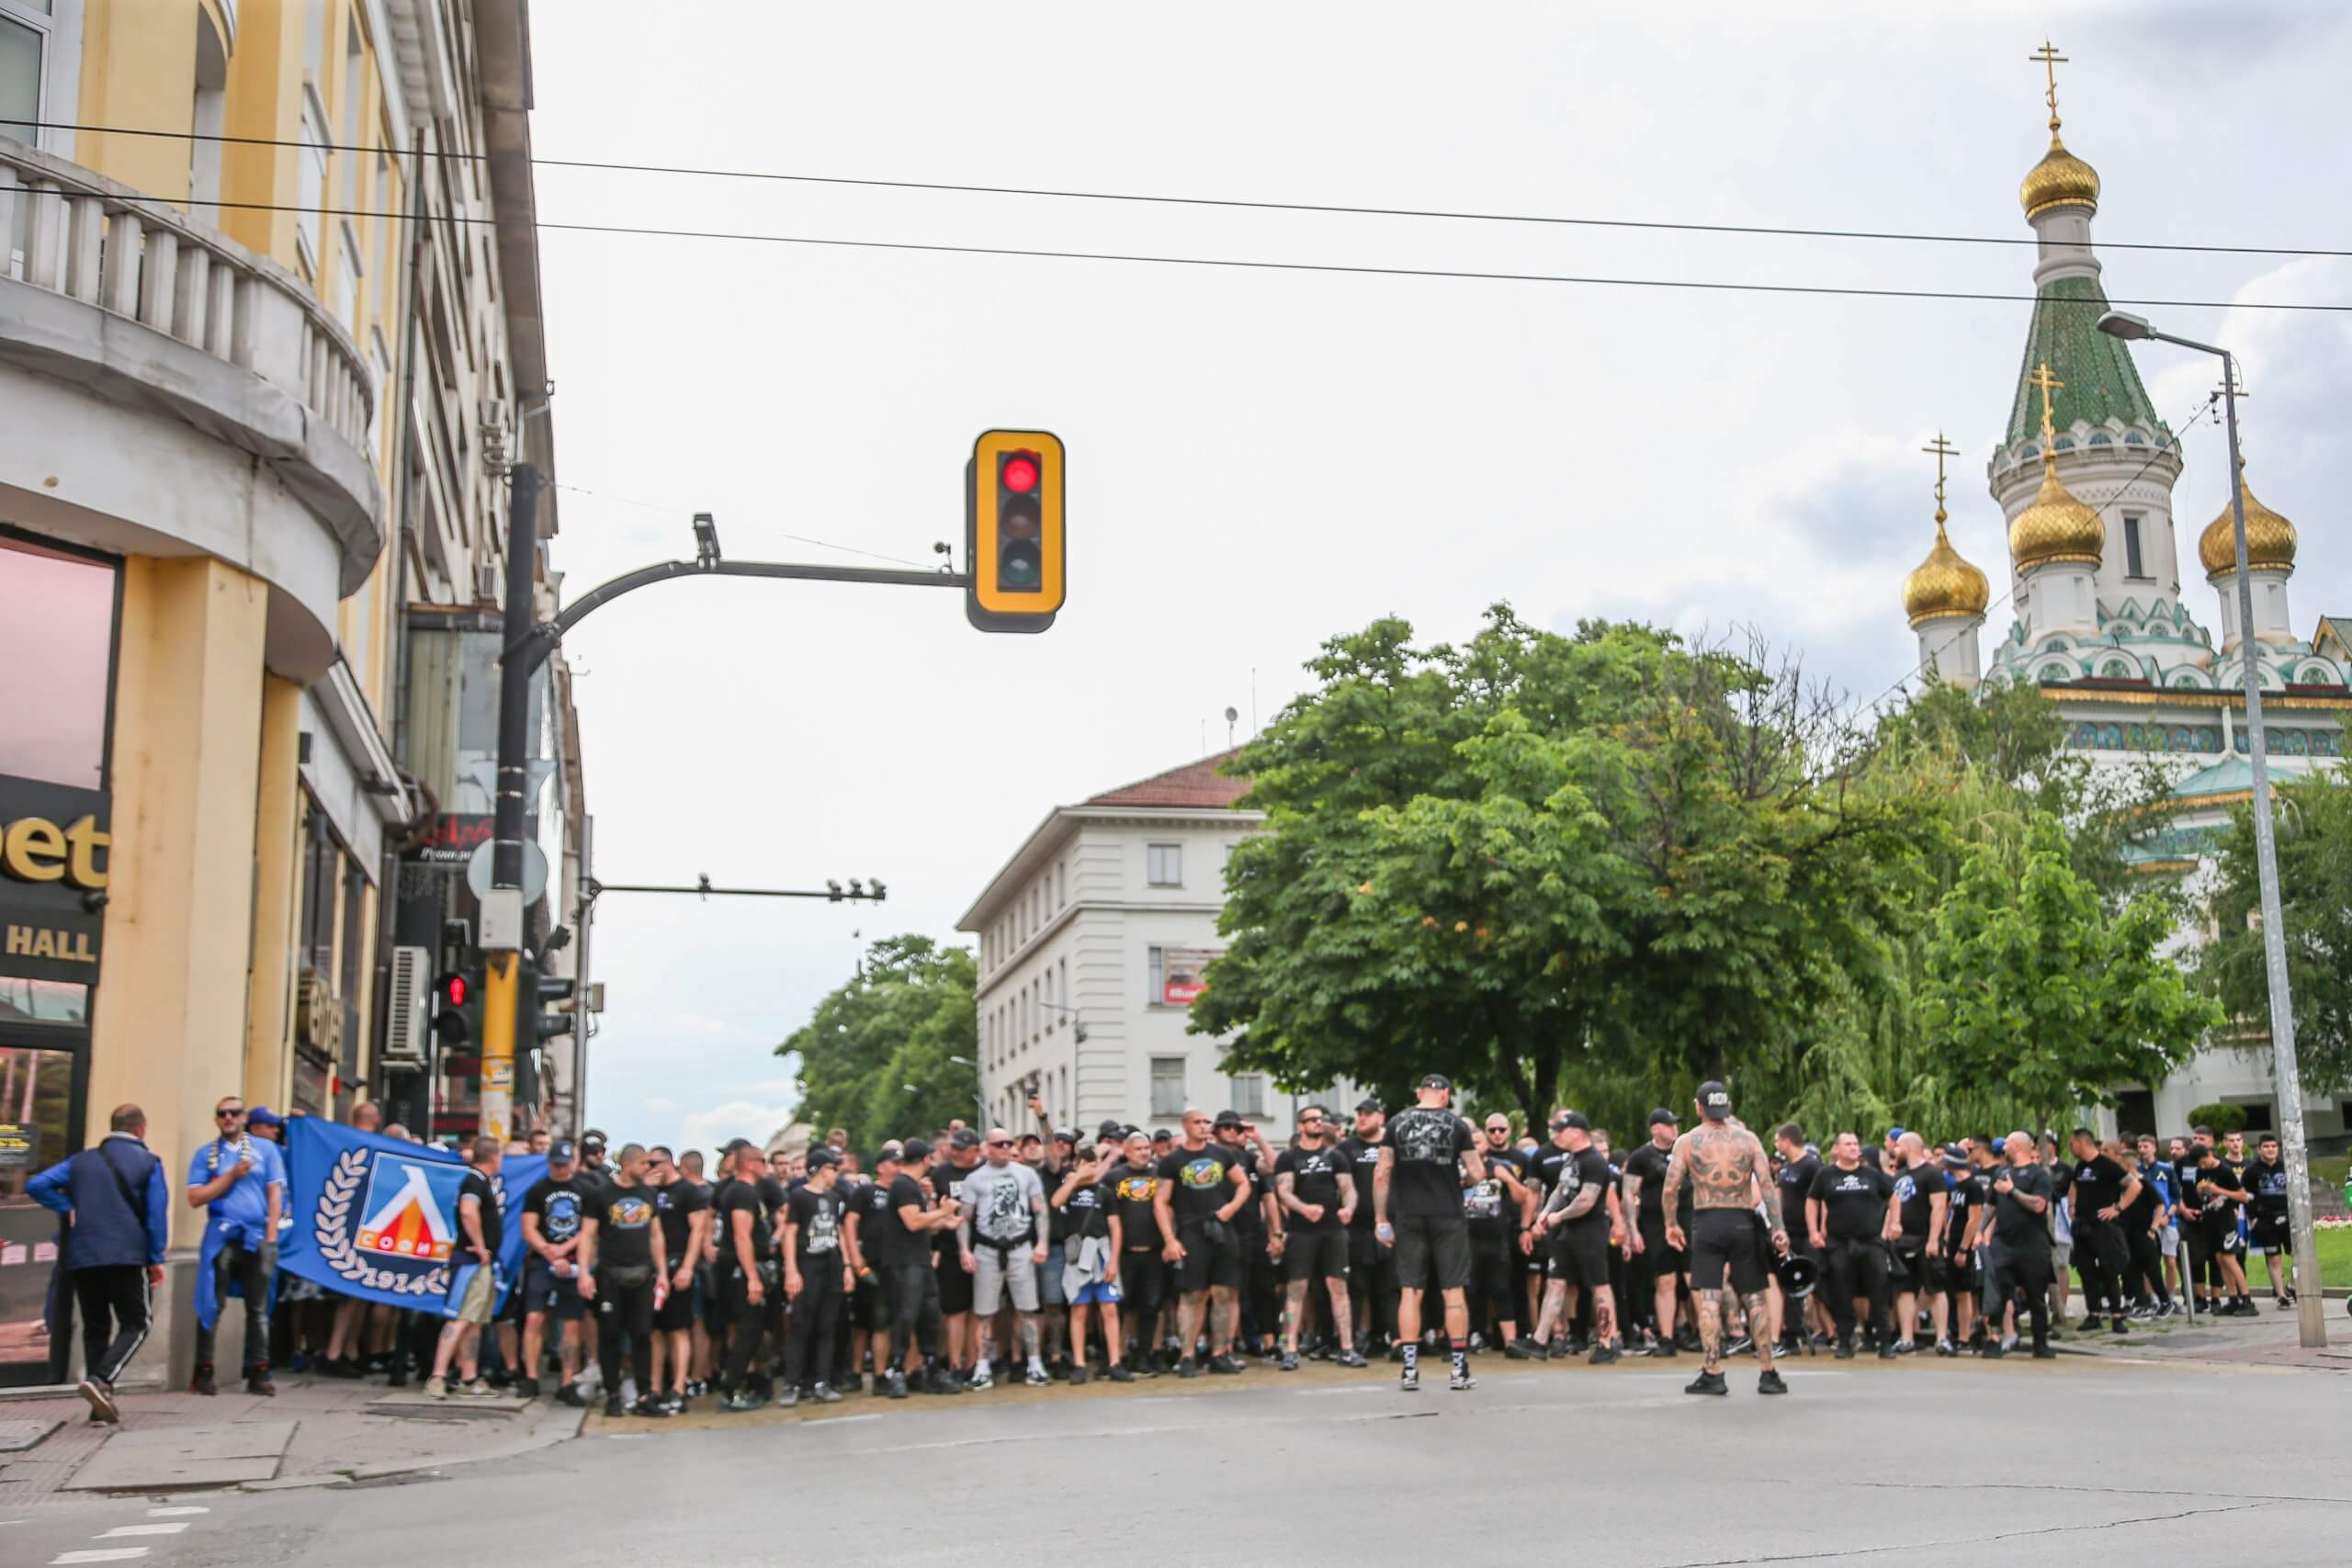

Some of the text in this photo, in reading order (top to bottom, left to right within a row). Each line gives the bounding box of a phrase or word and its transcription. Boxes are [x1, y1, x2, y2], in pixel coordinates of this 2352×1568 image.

[0, 815, 111, 888] et
[6, 924, 96, 963] HALL
[361, 1267, 427, 1295] 1914
